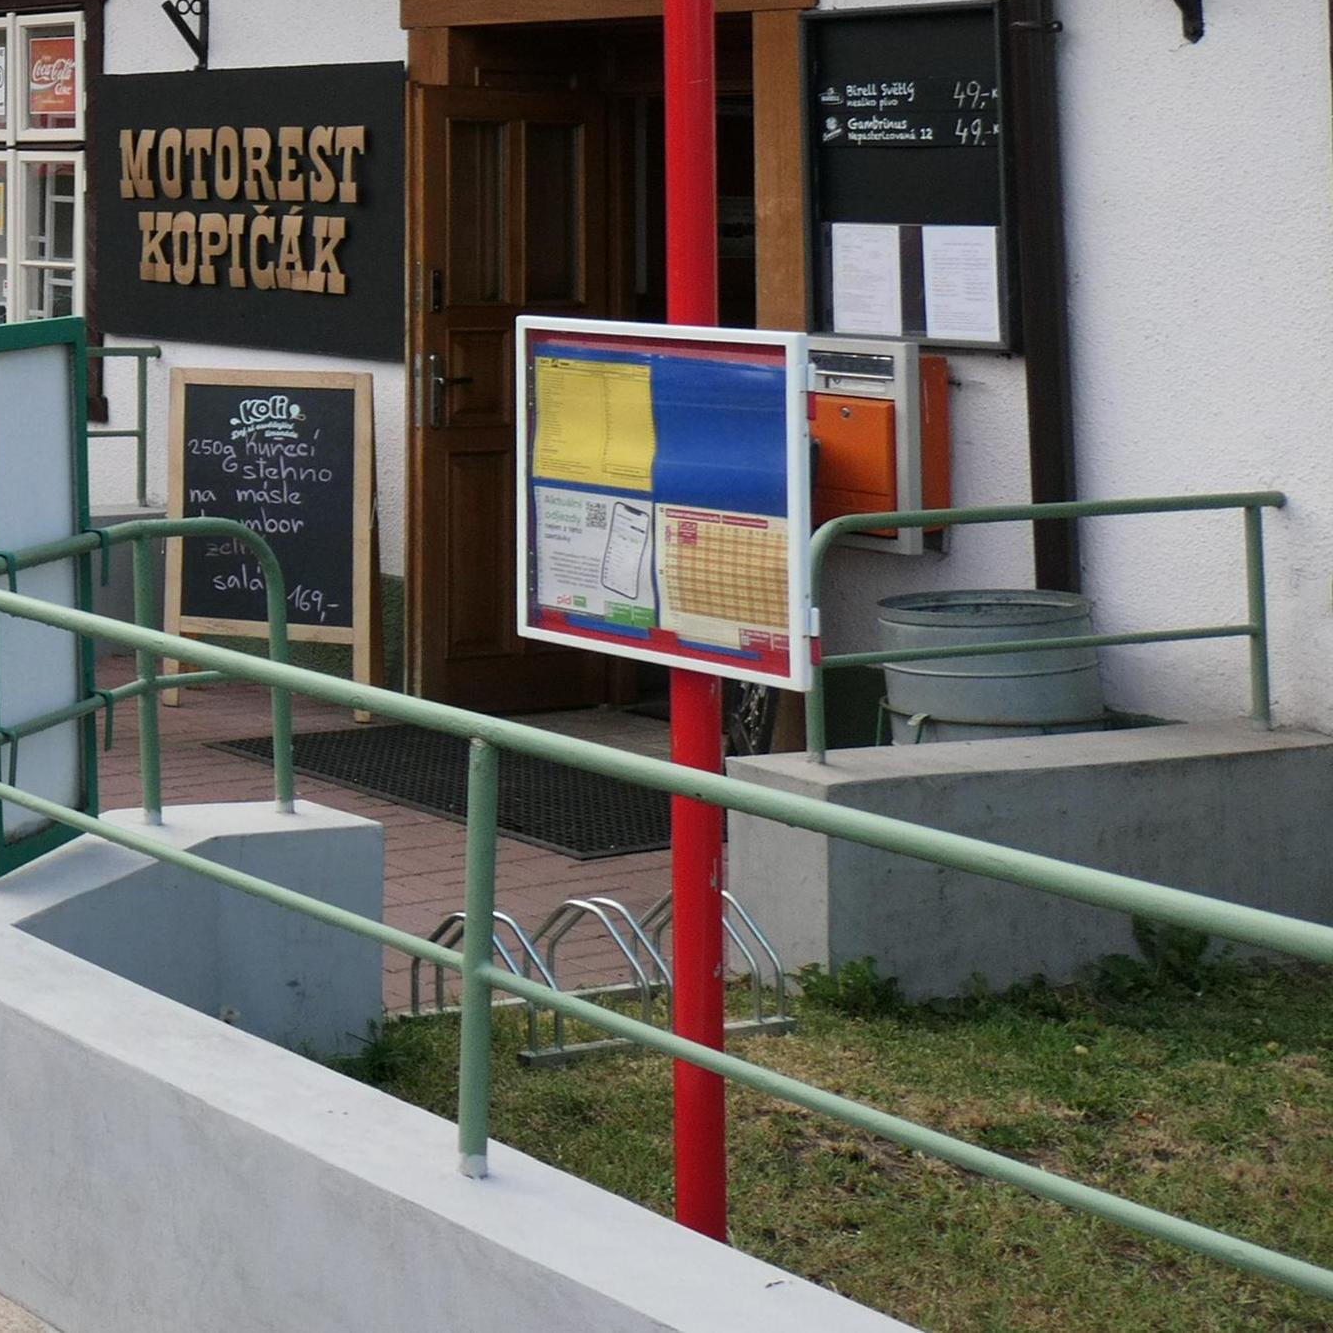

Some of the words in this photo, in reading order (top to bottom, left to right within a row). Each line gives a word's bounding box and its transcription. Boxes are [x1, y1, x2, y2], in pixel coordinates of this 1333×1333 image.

[846, 84, 878, 98] Birell
[880, 82, 915, 102] Světlý
[847, 115, 908, 131] Gambrinus
[919, 128, 934, 140] 12
[118, 124, 366, 203] MOTOREST
[138, 204, 348, 294] KOPIČÁK
[239, 395, 289, 425] Koli
[188, 438, 238, 473] 250g
[242, 455, 333, 482] stehno
[189, 487, 216, 503] na
[236, 481, 302, 504] másle
[212, 561, 265, 591] salá
